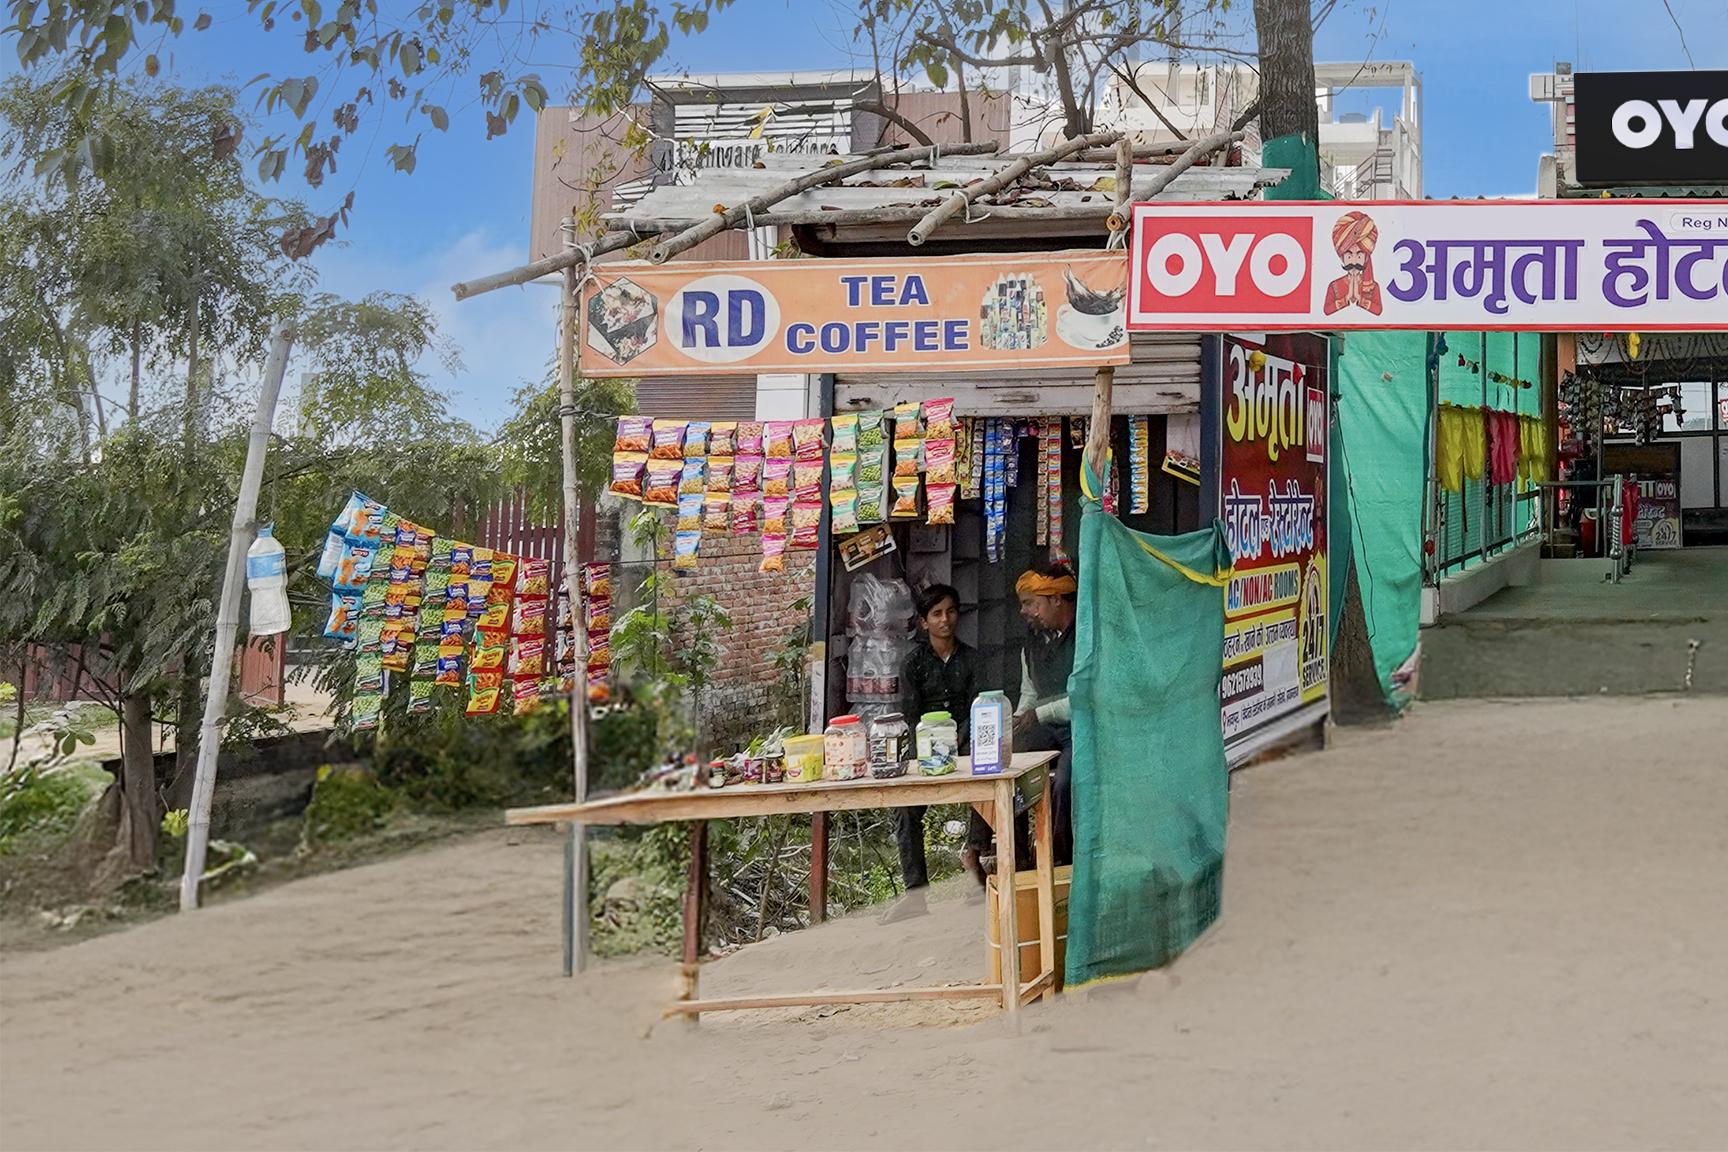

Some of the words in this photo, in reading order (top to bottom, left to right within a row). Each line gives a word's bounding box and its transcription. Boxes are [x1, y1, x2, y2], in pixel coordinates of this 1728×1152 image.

[1682, 217, 1712, 230] Reg
[1147, 232, 1307, 297] OYO
[1387, 238, 1585, 315] अमृता
[841, 275, 929, 306] TEA
[682, 290, 766, 348] RD
[786, 320, 970, 354] COFFEE
[1227, 344, 1306, 462] अमृता
[1308, 400, 1323, 447] OYO
[1657, 482, 1674, 496] OYO
[1228, 576, 1273, 610] AC/NON/AC
[1274, 569, 1299, 600] ROOMS
[1302, 614, 1325, 662] 24/7
[1302, 657, 1327, 689] SERVICE
